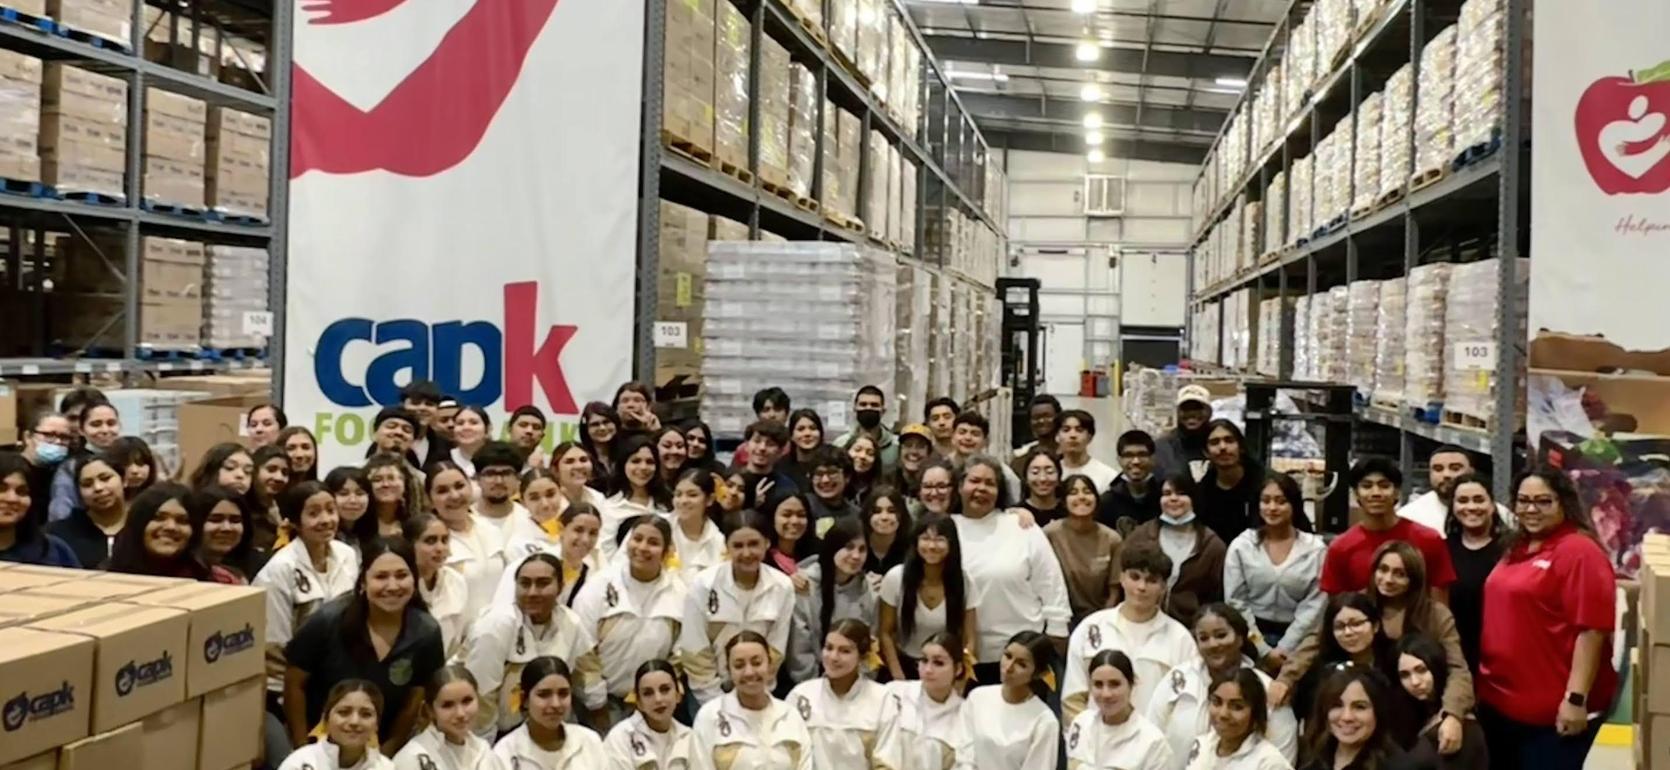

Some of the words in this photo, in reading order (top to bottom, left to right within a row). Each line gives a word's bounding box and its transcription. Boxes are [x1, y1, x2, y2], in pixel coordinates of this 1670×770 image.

[661, 326, 681, 336] 103
[314, 280, 579, 415] capk
[1464, 346, 1488, 357] 103
[223, 622, 255, 650] capk
[137, 650, 172, 681] capk
[30, 680, 75, 714] capk
